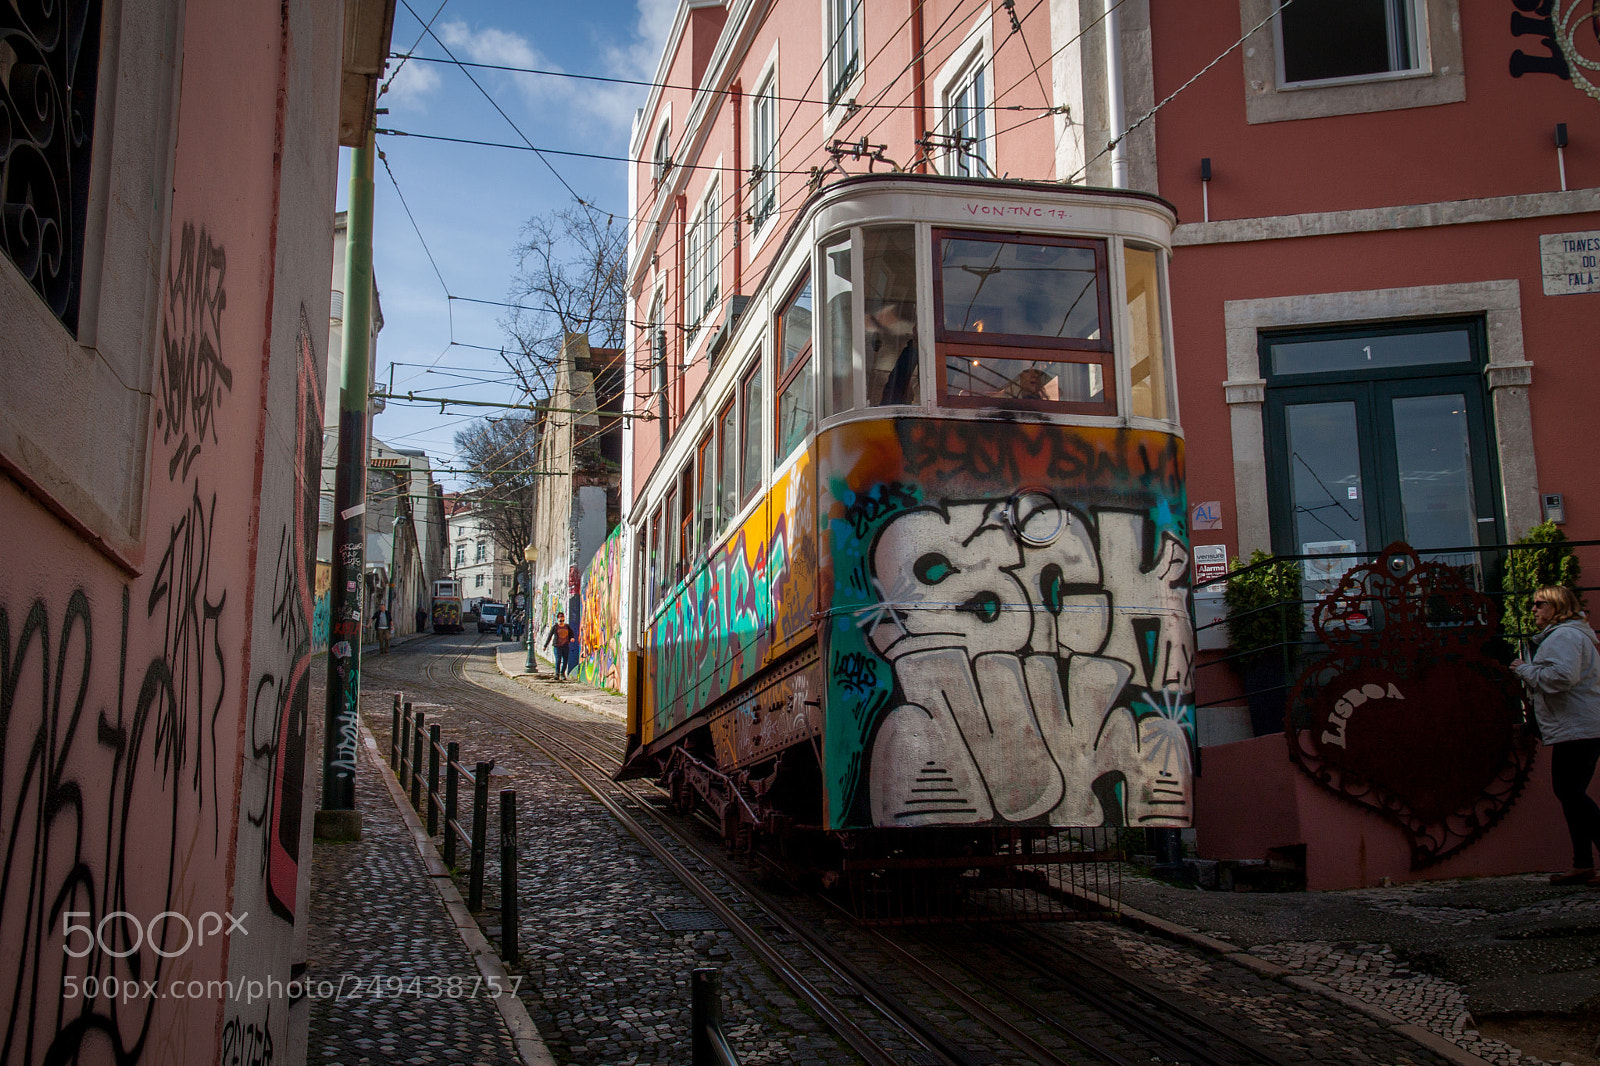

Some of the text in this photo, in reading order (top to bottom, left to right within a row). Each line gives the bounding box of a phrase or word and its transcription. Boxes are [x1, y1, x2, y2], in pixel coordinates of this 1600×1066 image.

[1563, 238, 1600, 253] TRAVES
[1582, 255, 1597, 268] DO
[1362, 345, 1372, 360] 1
[1195, 506, 1218, 521] AL
[1199, 564, 1225, 572] Alarme
[1321, 682, 1406, 749] LISBOA
